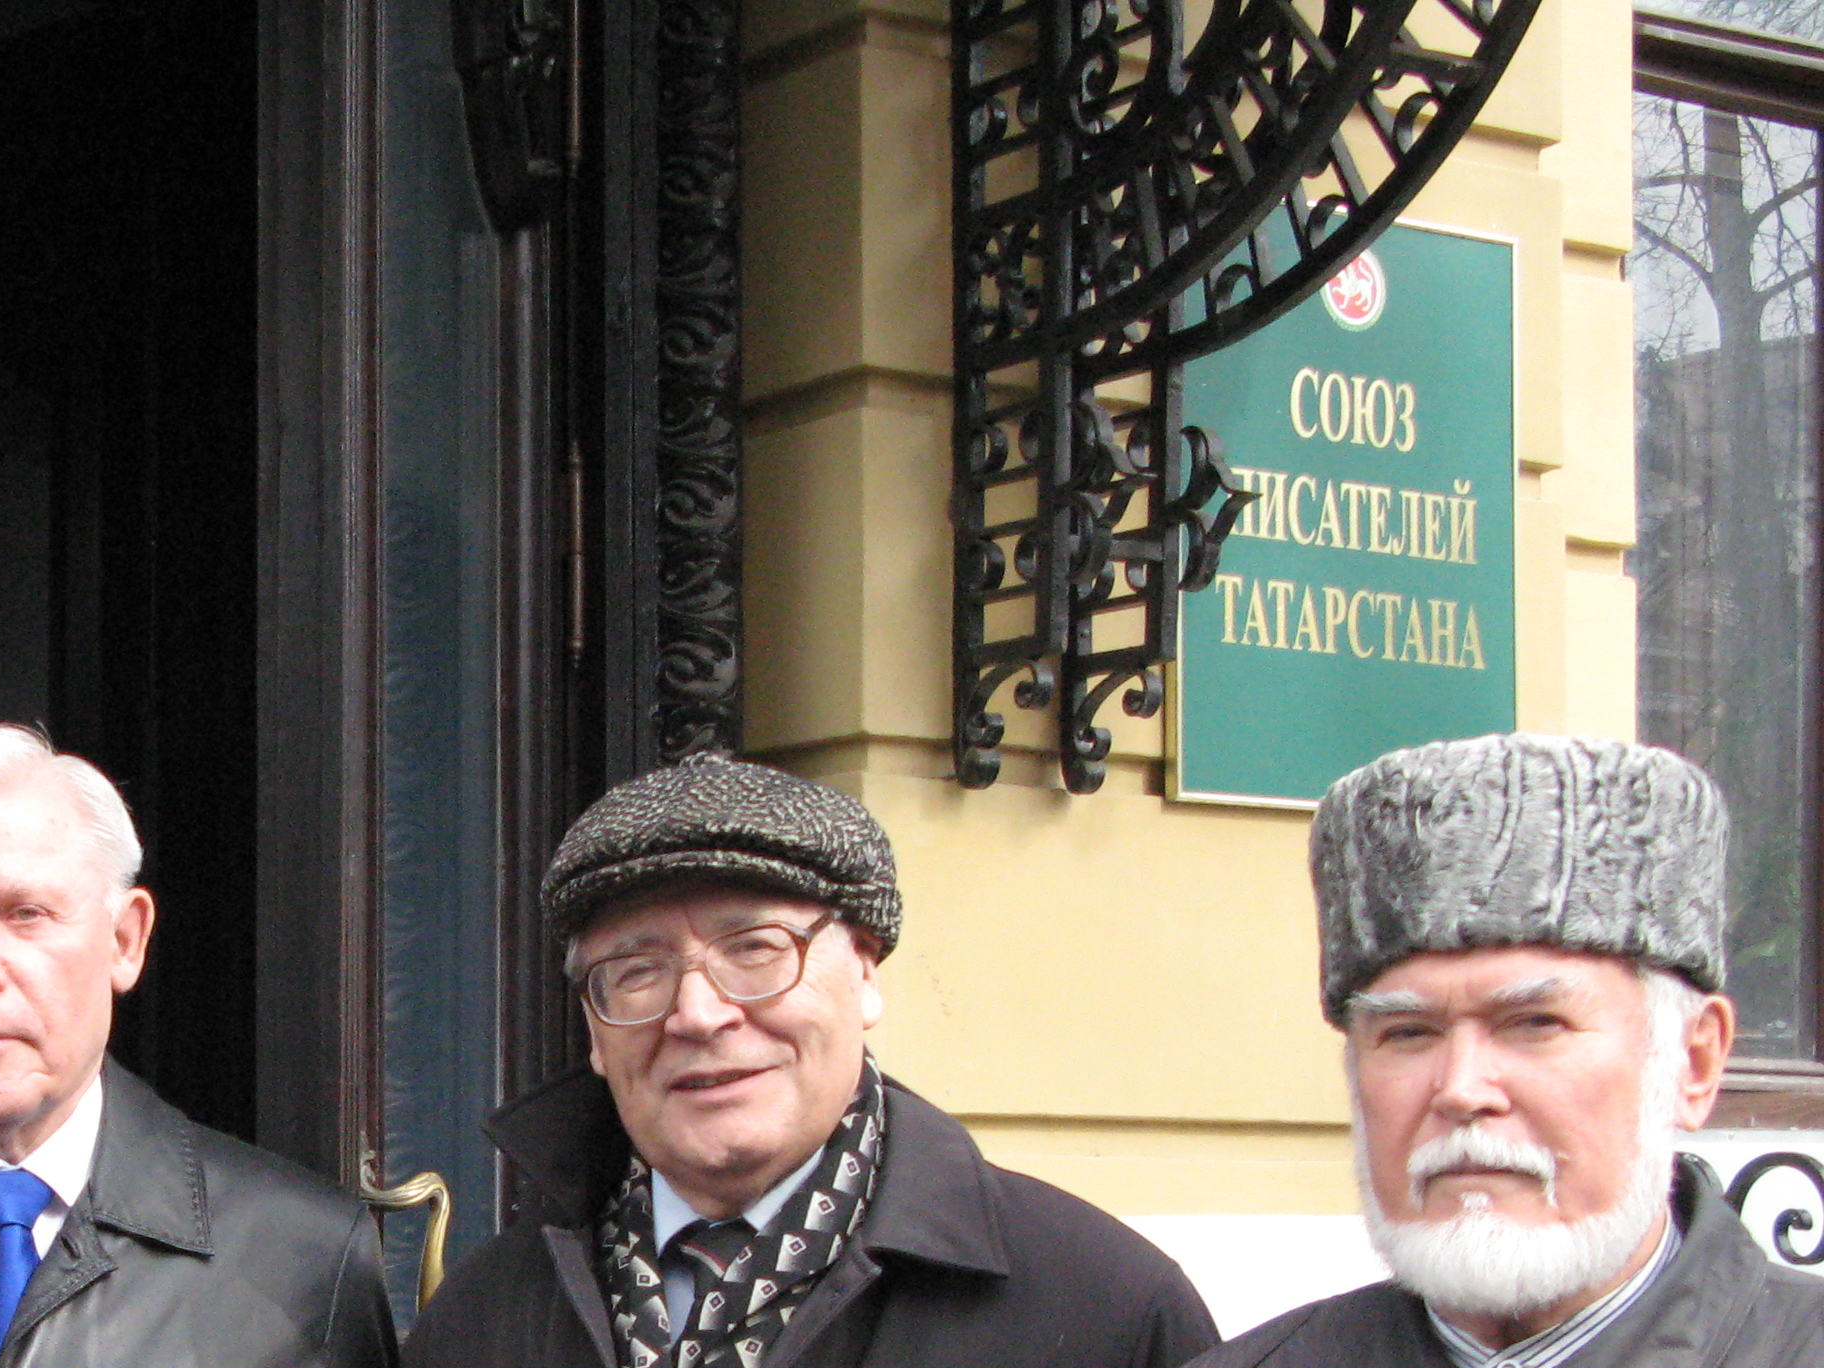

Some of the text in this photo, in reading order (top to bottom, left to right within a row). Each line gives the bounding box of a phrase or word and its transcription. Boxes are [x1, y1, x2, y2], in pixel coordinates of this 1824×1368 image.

[1290, 366, 1417, 453] СОЮЗ
[1229, 472, 1478, 566] ПИСАТЕЛЕЙ
[1214, 573, 1485, 671] ТАТАРСТАНА
